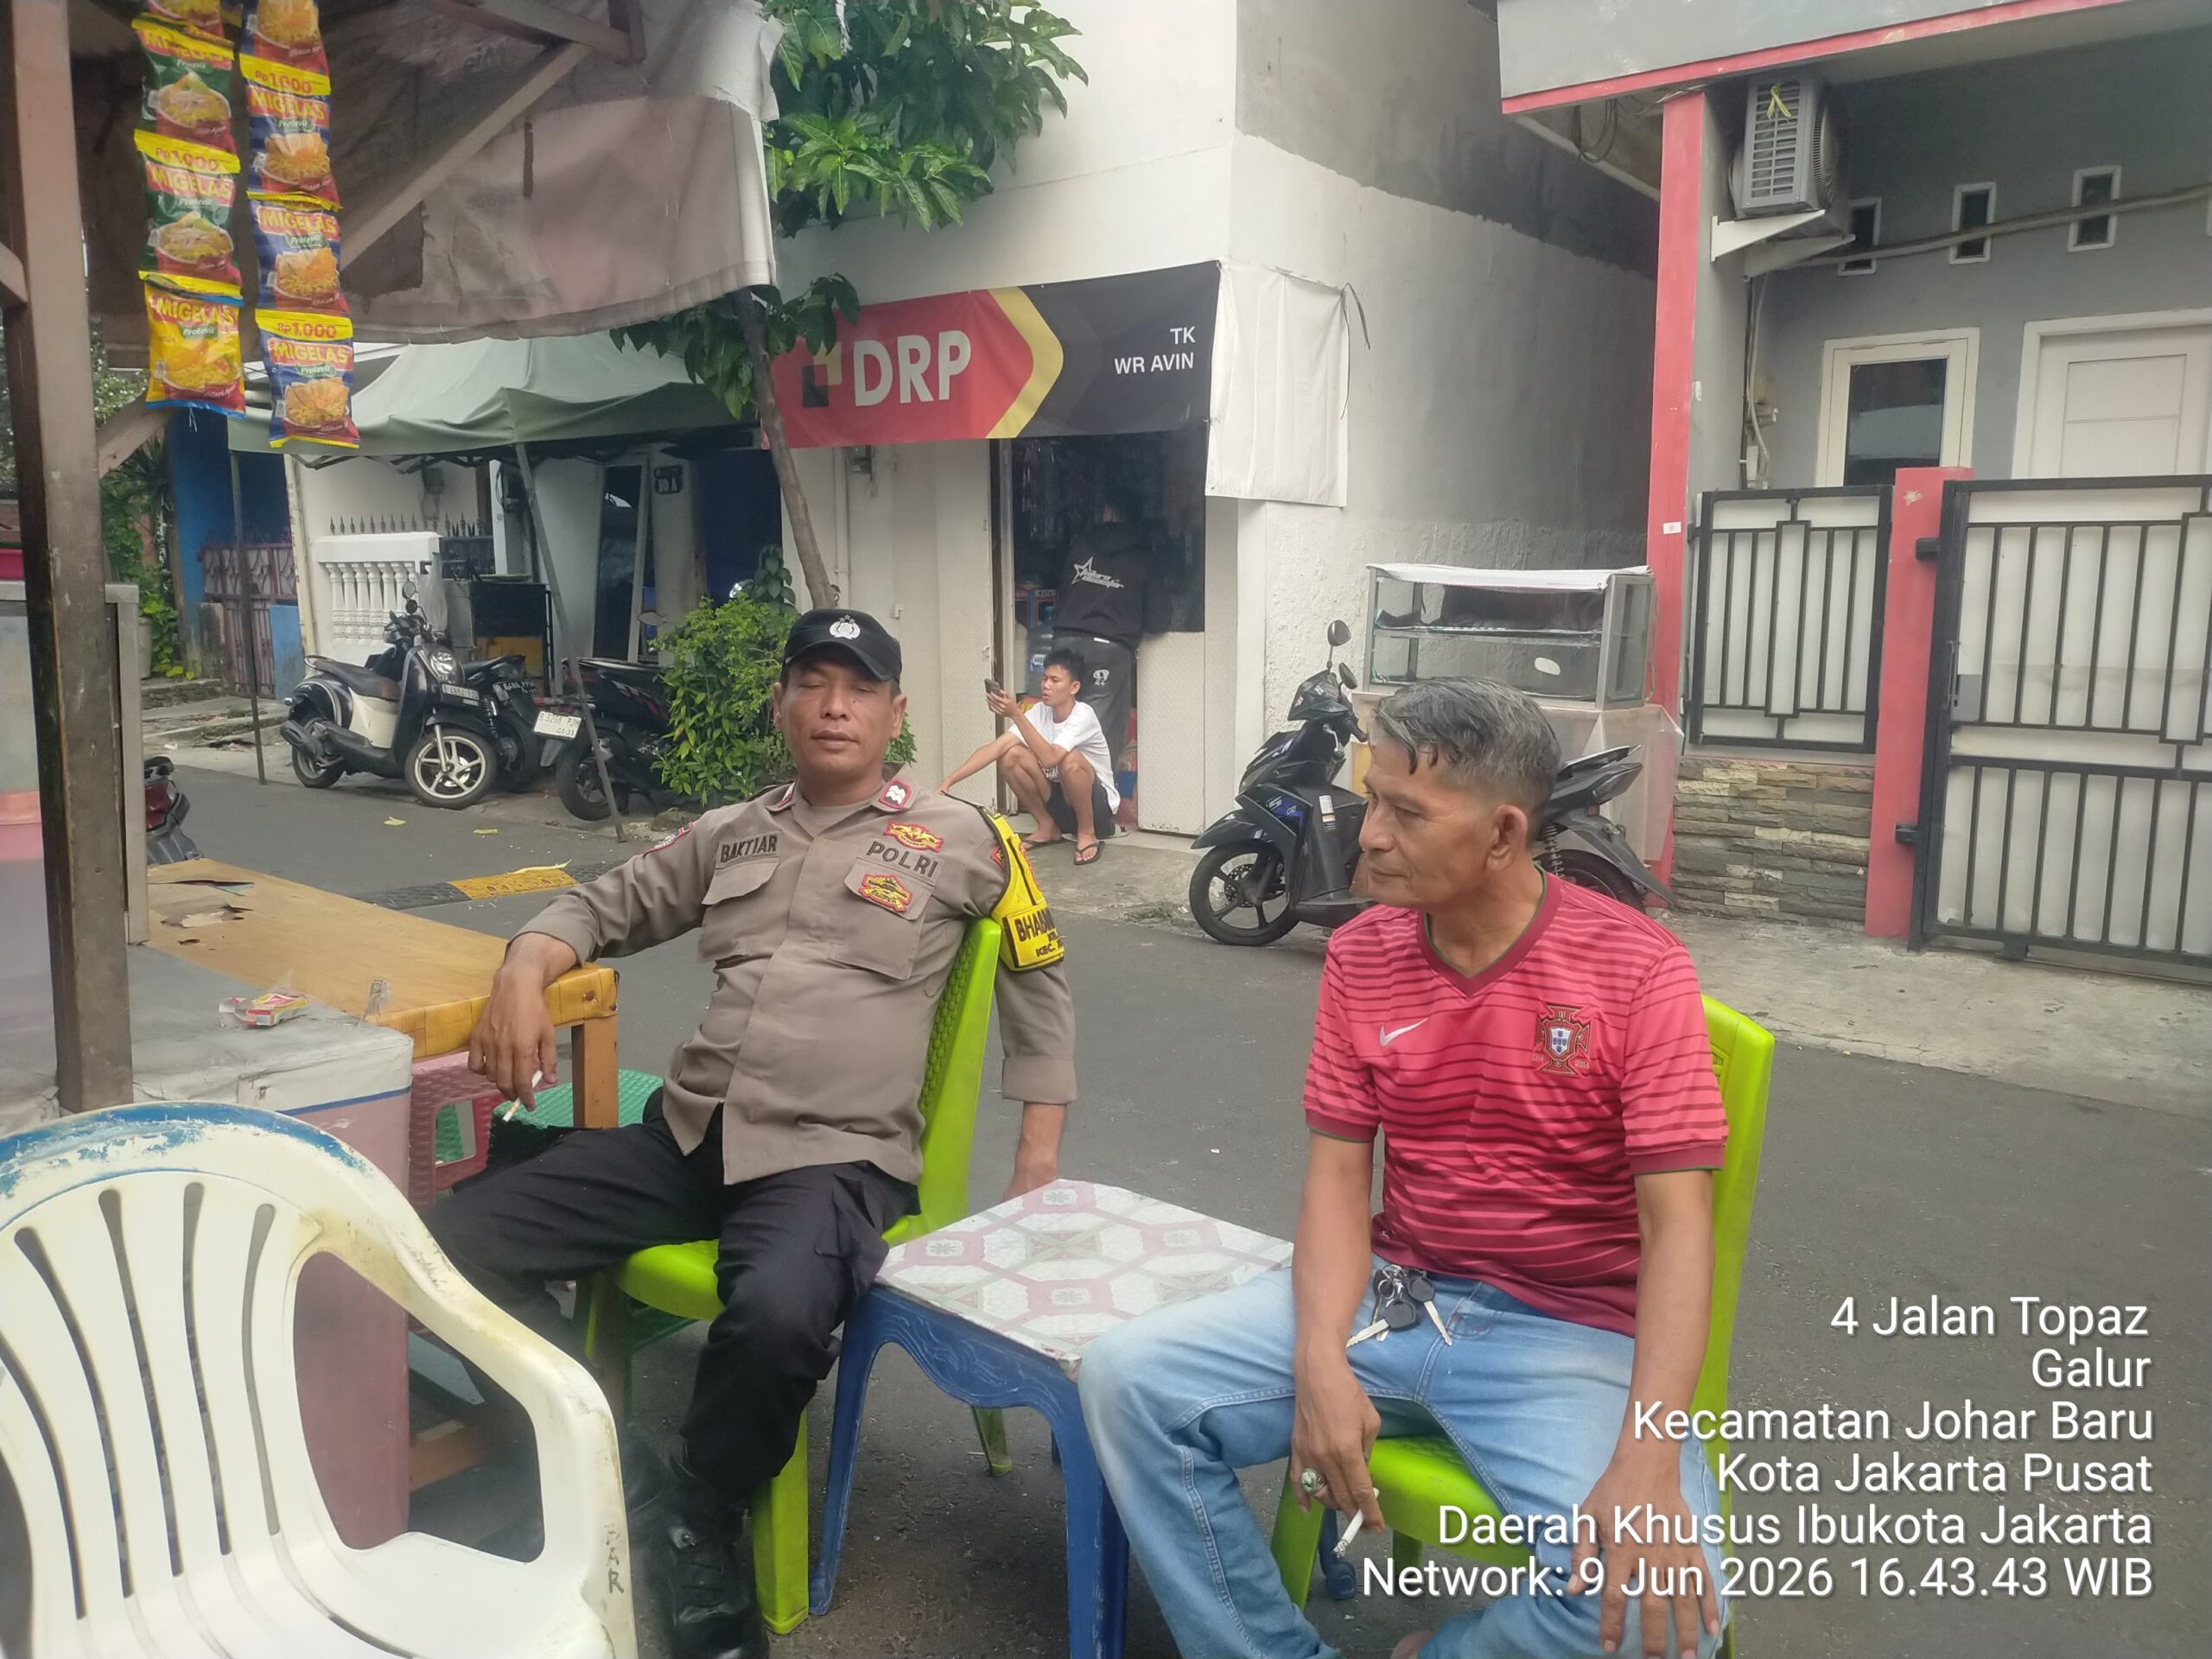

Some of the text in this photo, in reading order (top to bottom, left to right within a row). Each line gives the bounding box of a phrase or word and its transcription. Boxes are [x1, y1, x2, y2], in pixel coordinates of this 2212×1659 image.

[251, 86, 326, 121] MIGELAS
[151, 165, 233, 200] MIGELAS
[262, 207, 337, 234] MIGELAS
[156, 297, 235, 327] MIGELAS
[277, 321, 337, 339] Rp1.000
[1169, 325, 1196, 345] TK
[273, 341, 349, 365] MIGELAS
[1114, 352, 1195, 375] WR AVIN
[853, 329, 972, 407] DRP
[720, 834, 779, 863] BAKTIAR
[865, 840, 939, 878] POLRI
